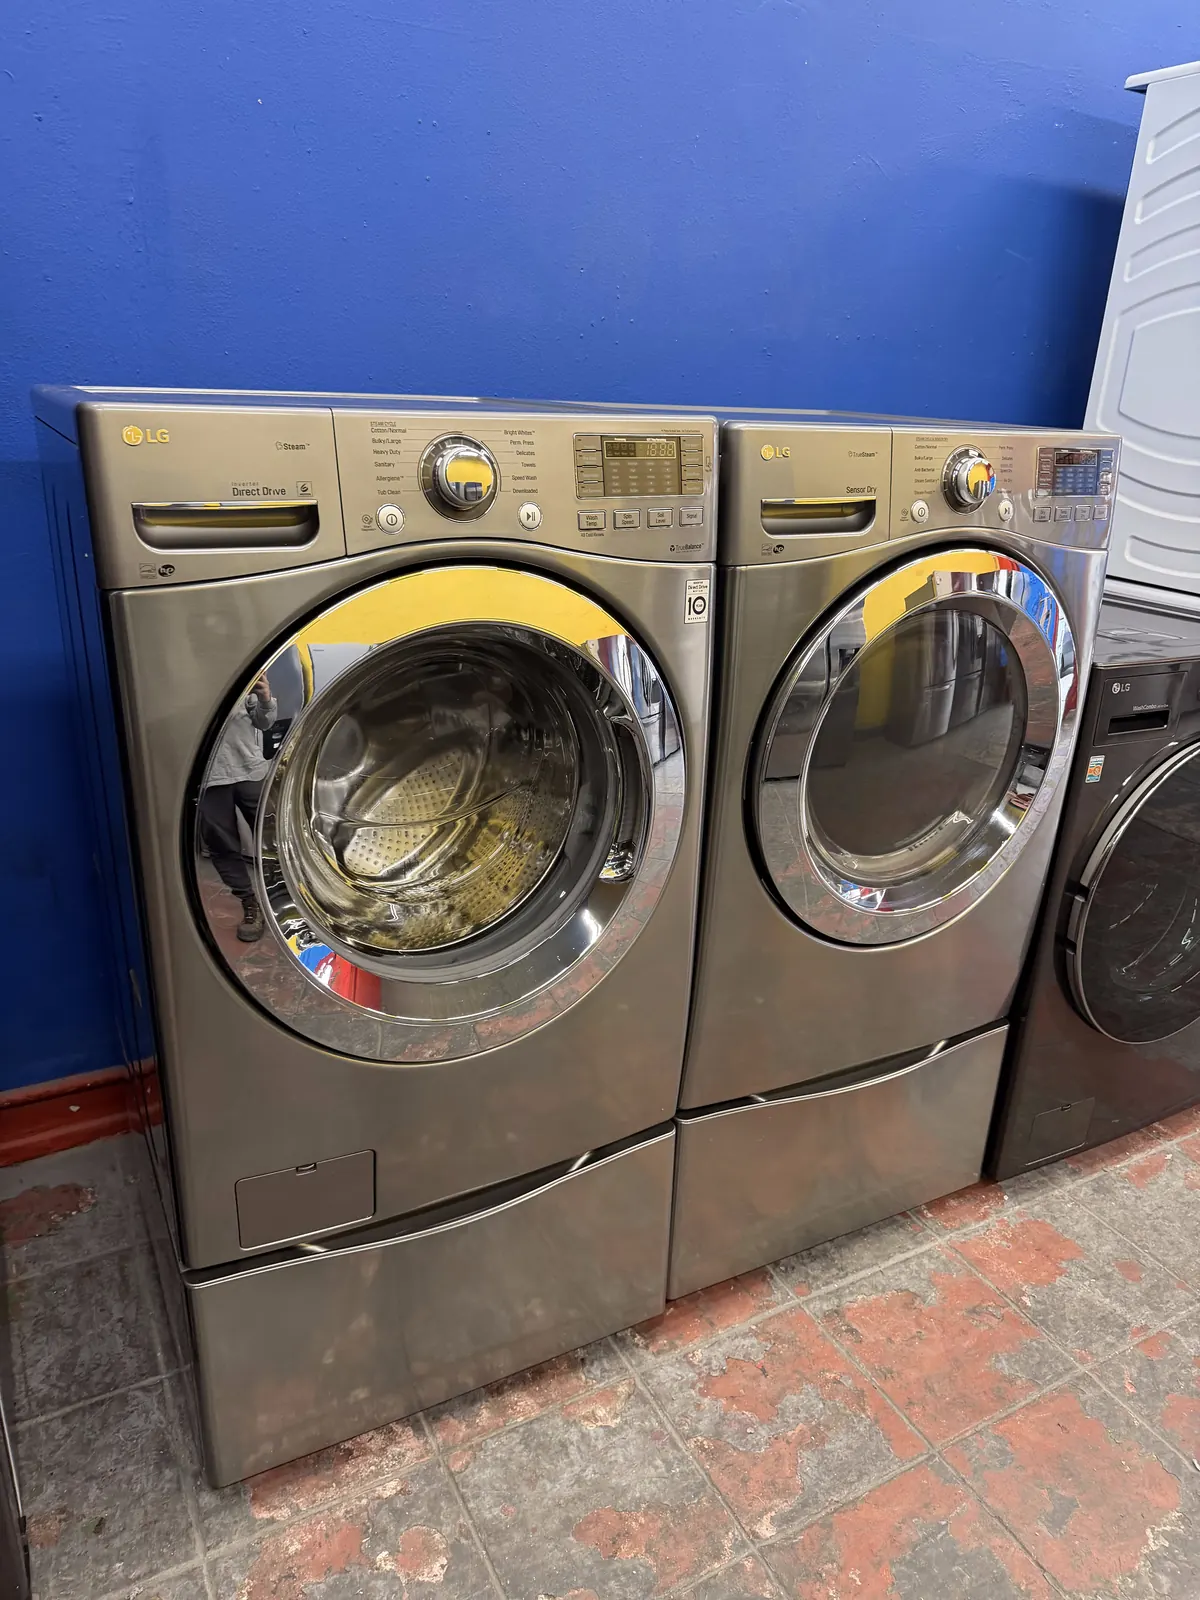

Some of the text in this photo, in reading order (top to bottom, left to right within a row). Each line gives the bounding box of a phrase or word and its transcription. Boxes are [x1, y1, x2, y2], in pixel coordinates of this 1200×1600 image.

[146, 428, 170, 443] LG
[371, 437, 402, 445] Bulky/Large
[775, 446, 791, 459] LG
[232, 486, 287, 497] Direct Drive
[846, 485, 877, 495] Sensor Dry
[687, 595, 707, 616] 10
[1120, 683, 1131, 692] LG
